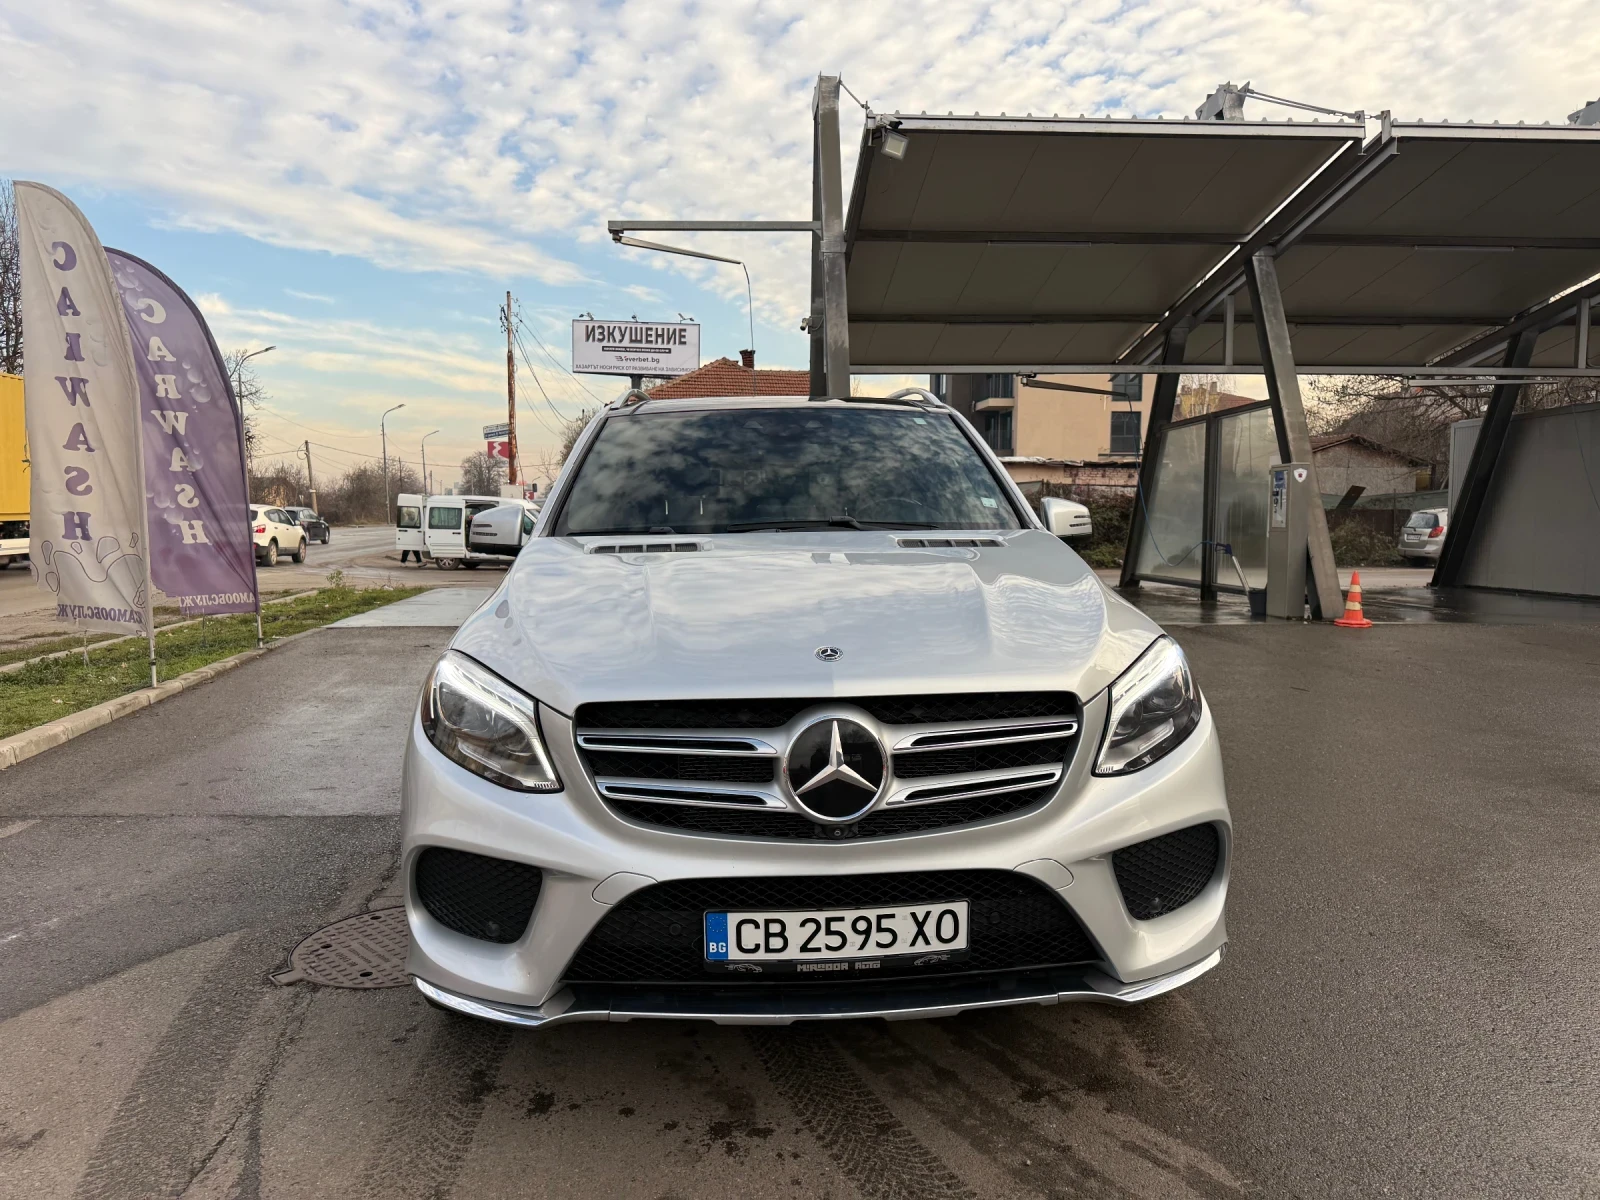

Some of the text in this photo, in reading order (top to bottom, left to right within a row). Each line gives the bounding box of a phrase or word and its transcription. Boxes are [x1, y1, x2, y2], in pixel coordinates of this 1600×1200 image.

[585, 324, 687, 345] ИЗКУШЕНИЕ
[709, 908, 960, 954] BG CB 2595 XO
[854, 960, 881, 970] AUTO
